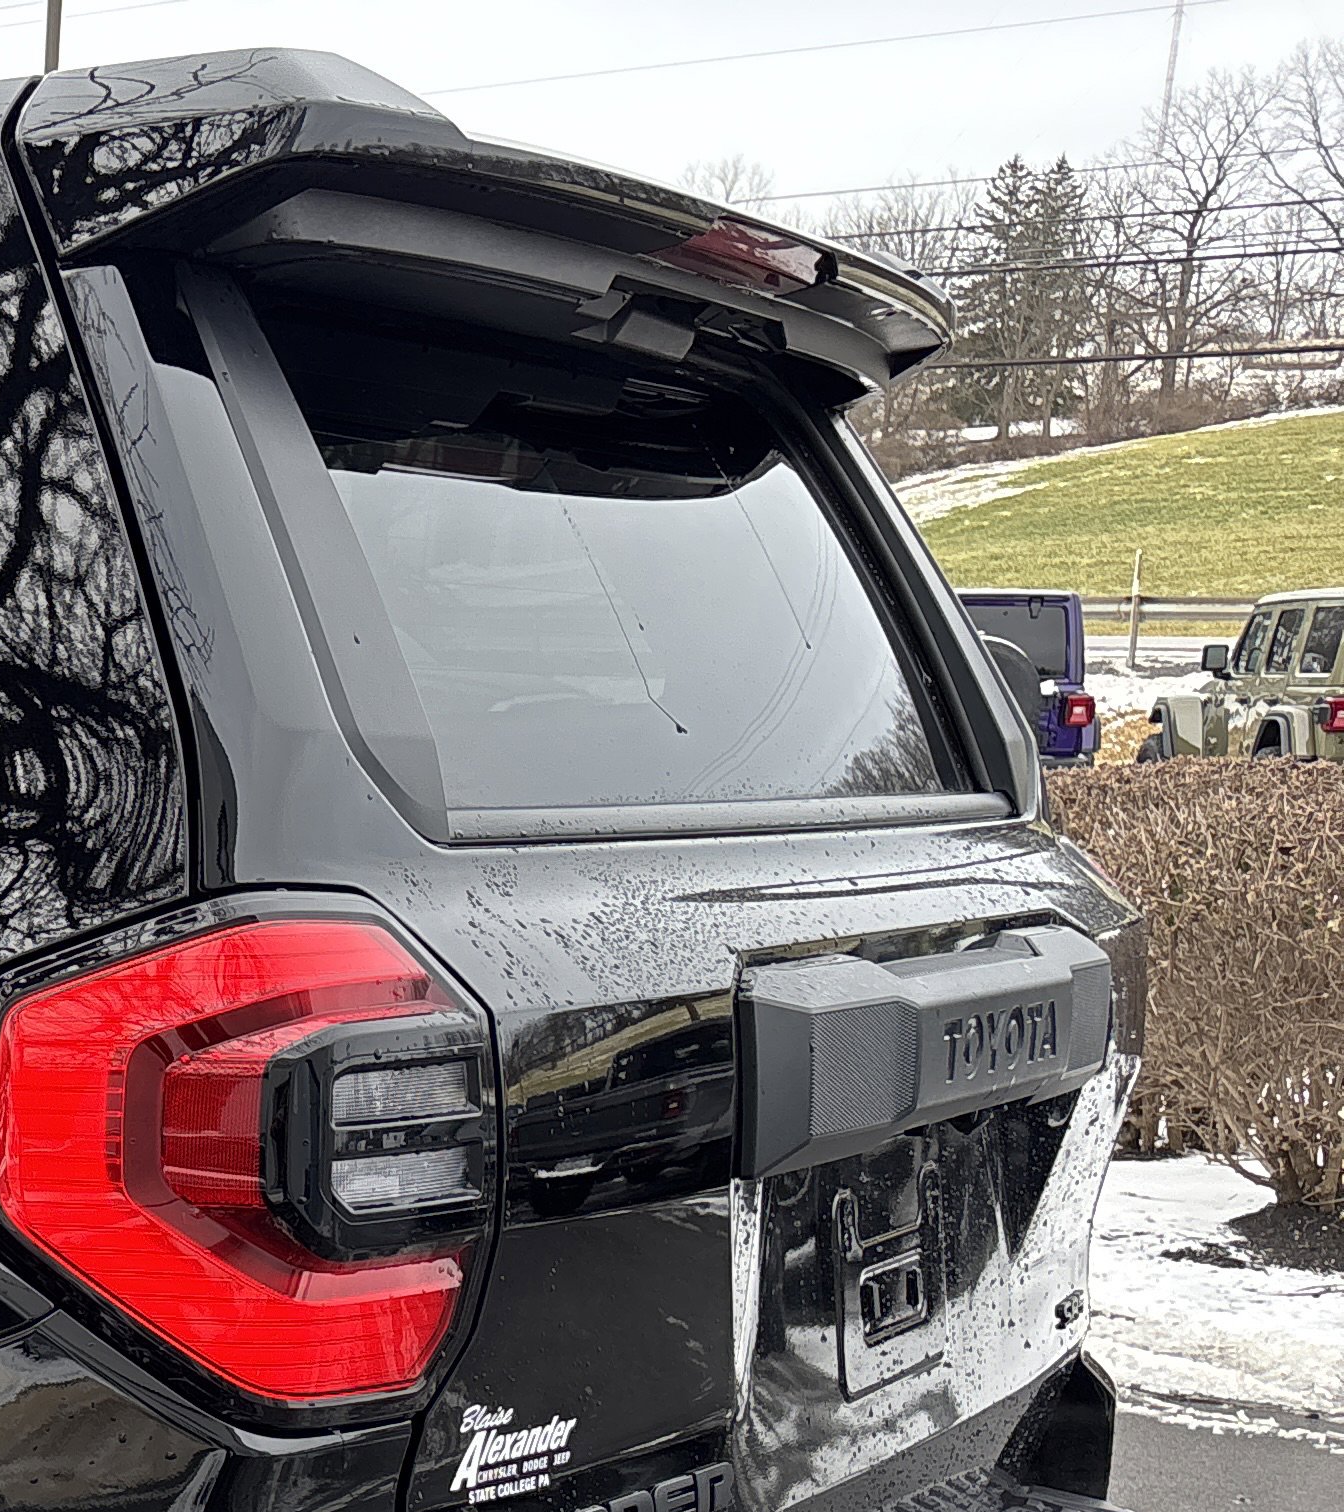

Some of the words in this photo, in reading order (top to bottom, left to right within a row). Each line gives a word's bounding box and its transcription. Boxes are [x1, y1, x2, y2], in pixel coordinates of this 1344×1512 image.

[943, 999, 1056, 1084] TOYOTA
[460, 1404, 514, 1434] Blaise
[450, 1415, 577, 1491] Alexander
[478, 1463, 518, 1483] CHRYSLER
[522, 1456, 549, 1473] DODGE
[552, 1451, 571, 1466] JEEP
[468, 1486, 496, 1505] STATE
[497, 1476, 536, 1498] COLLEGE
[538, 1474, 550, 1488] PA
